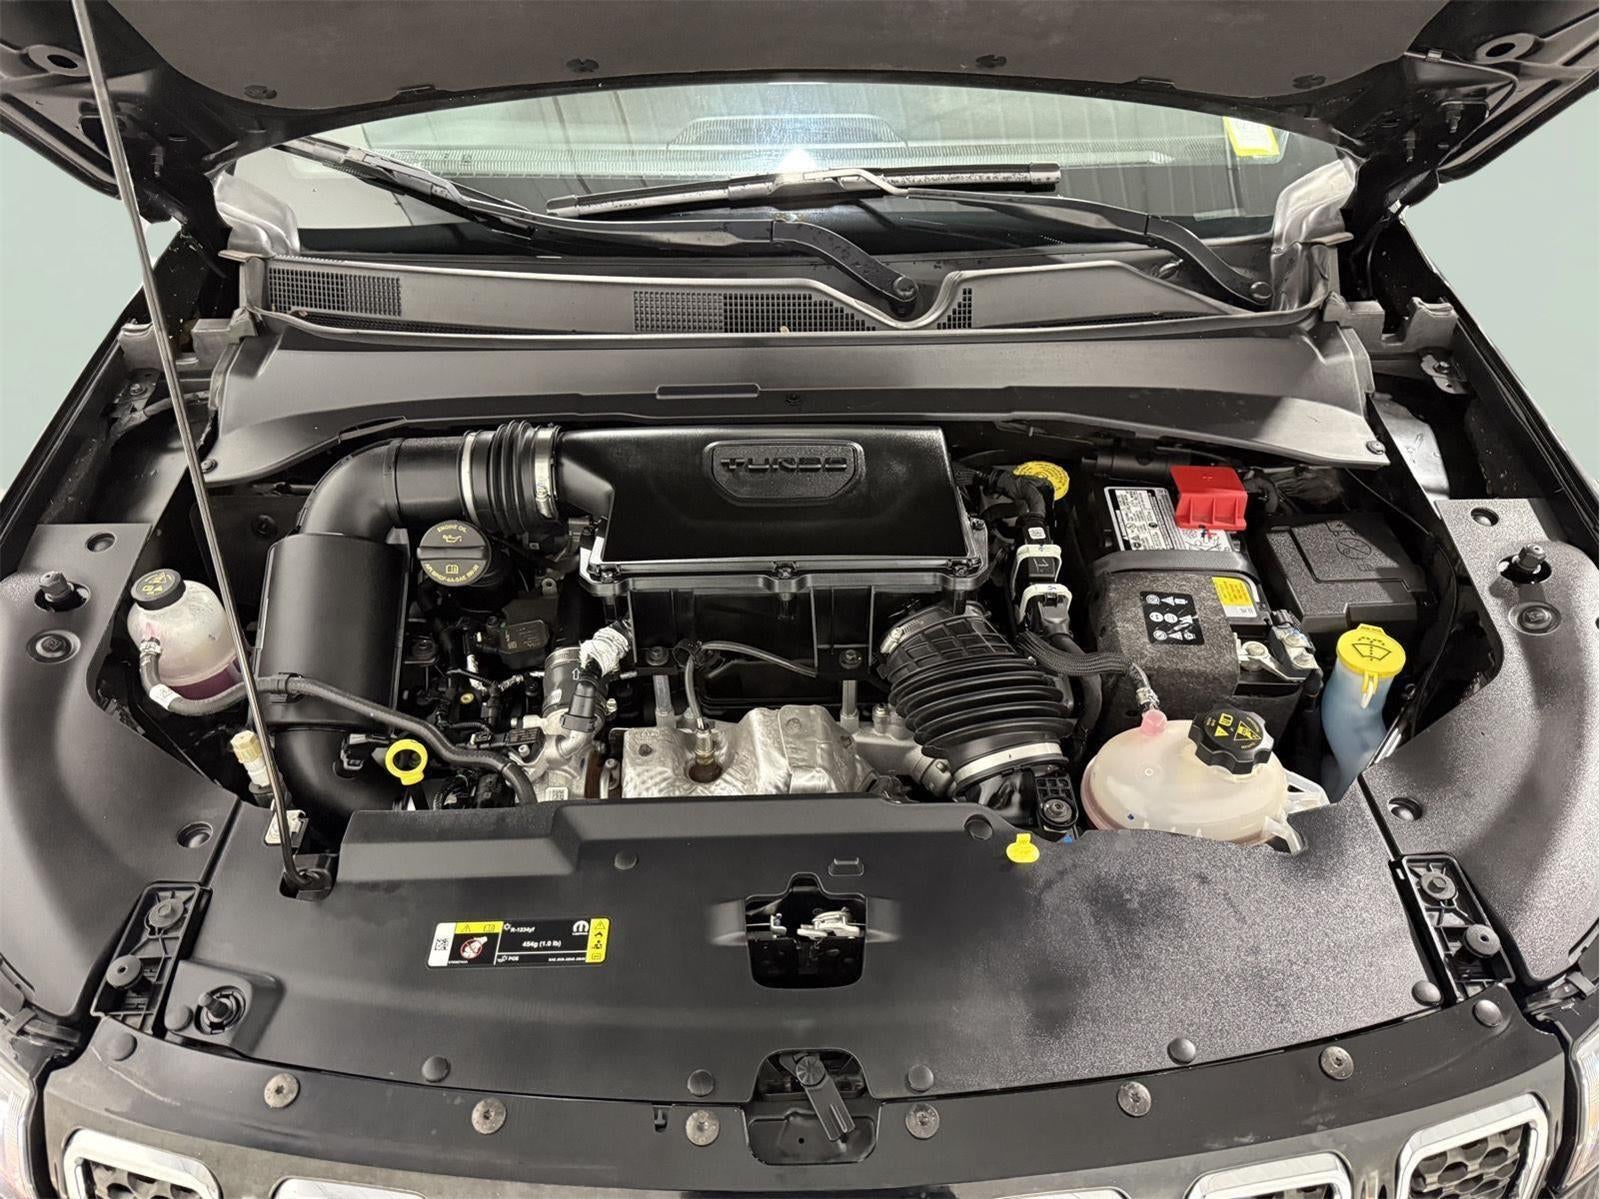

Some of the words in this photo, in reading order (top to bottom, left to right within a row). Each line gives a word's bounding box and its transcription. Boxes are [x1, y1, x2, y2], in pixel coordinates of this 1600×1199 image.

[720, 457, 848, 472] TURBO
[437, 524, 458, 532] ENGINE
[458, 525, 468, 533] OIL
